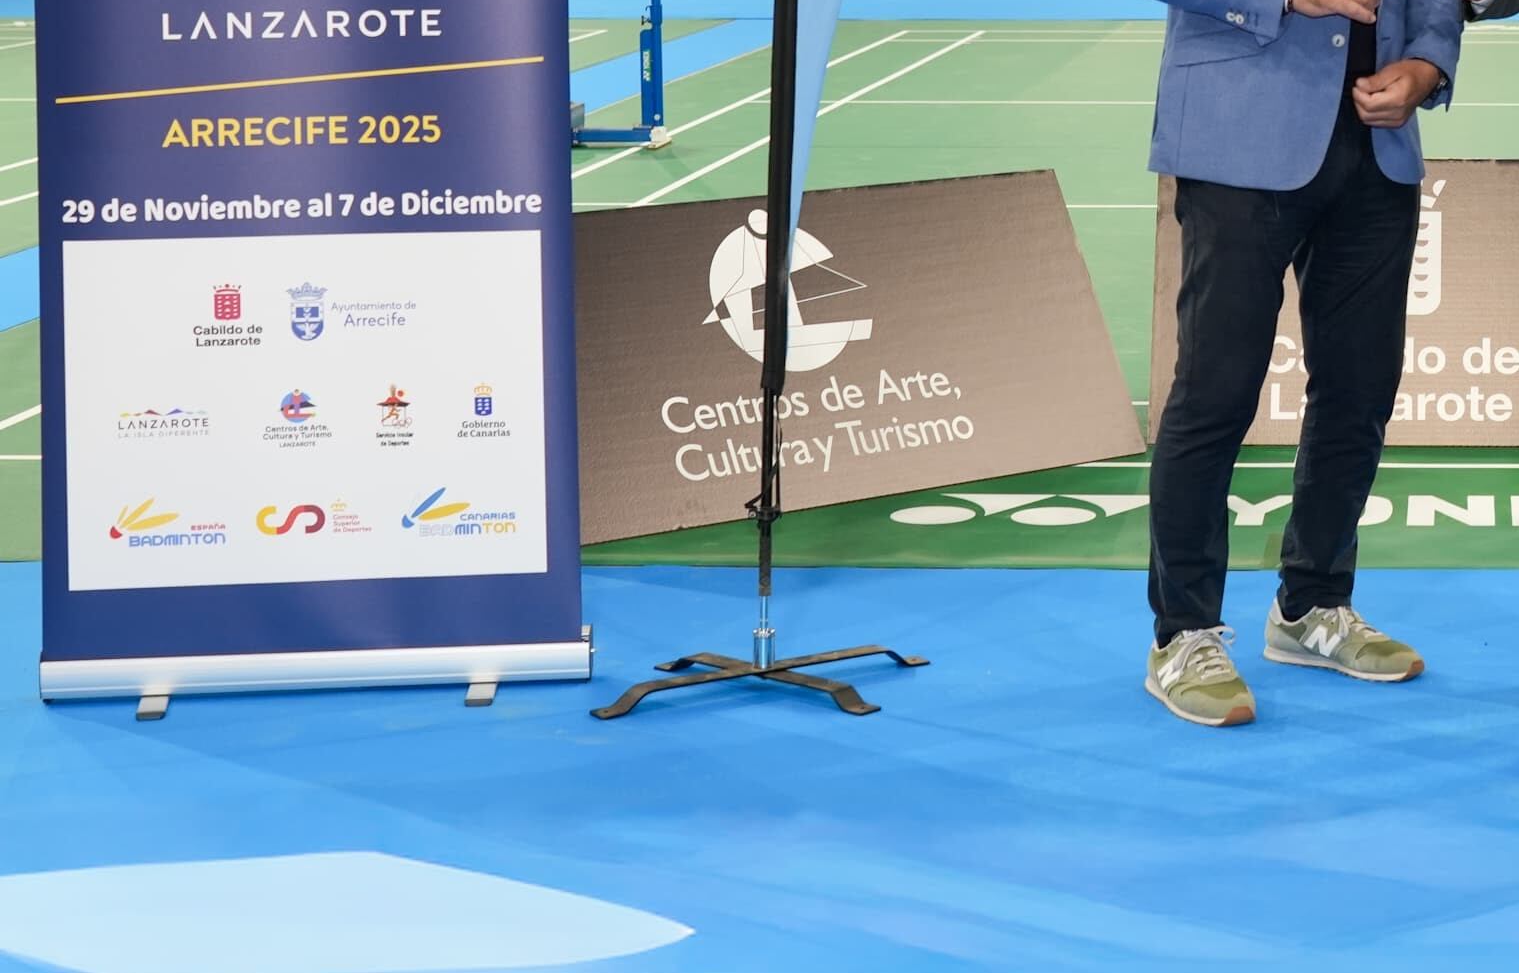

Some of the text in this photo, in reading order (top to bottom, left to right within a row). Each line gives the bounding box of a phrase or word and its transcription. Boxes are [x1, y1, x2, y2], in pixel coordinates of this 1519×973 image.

[162, 9, 443, 41] LANZAROTE
[161, 114, 442, 148] ARRECIFE 2025
[62, 188, 542, 224] 29 de Noviembre al 7 de Diciembre
[331, 300, 417, 312] Ayuntamiento de
[343, 313, 406, 328] Arrecife
[193, 325, 263, 336] Cabildo de
[195, 337, 261, 348] Lanzarote
[661, 369, 963, 434] Centros de Arte,
[1270, 382, 1513, 422] Larote
[118, 418, 209, 430] LANZAROTE
[462, 420, 506, 429] Gobierno
[301, 431, 332, 439] Turismo
[457, 428, 511, 438] de Canarias
[812, 435, 834, 473] y
[835, 415, 975, 457] Turismo
[460, 511, 516, 521] CANARIAS
[129, 532, 226, 547] BADMINTON
[1303, 625, 1342, 657] N
